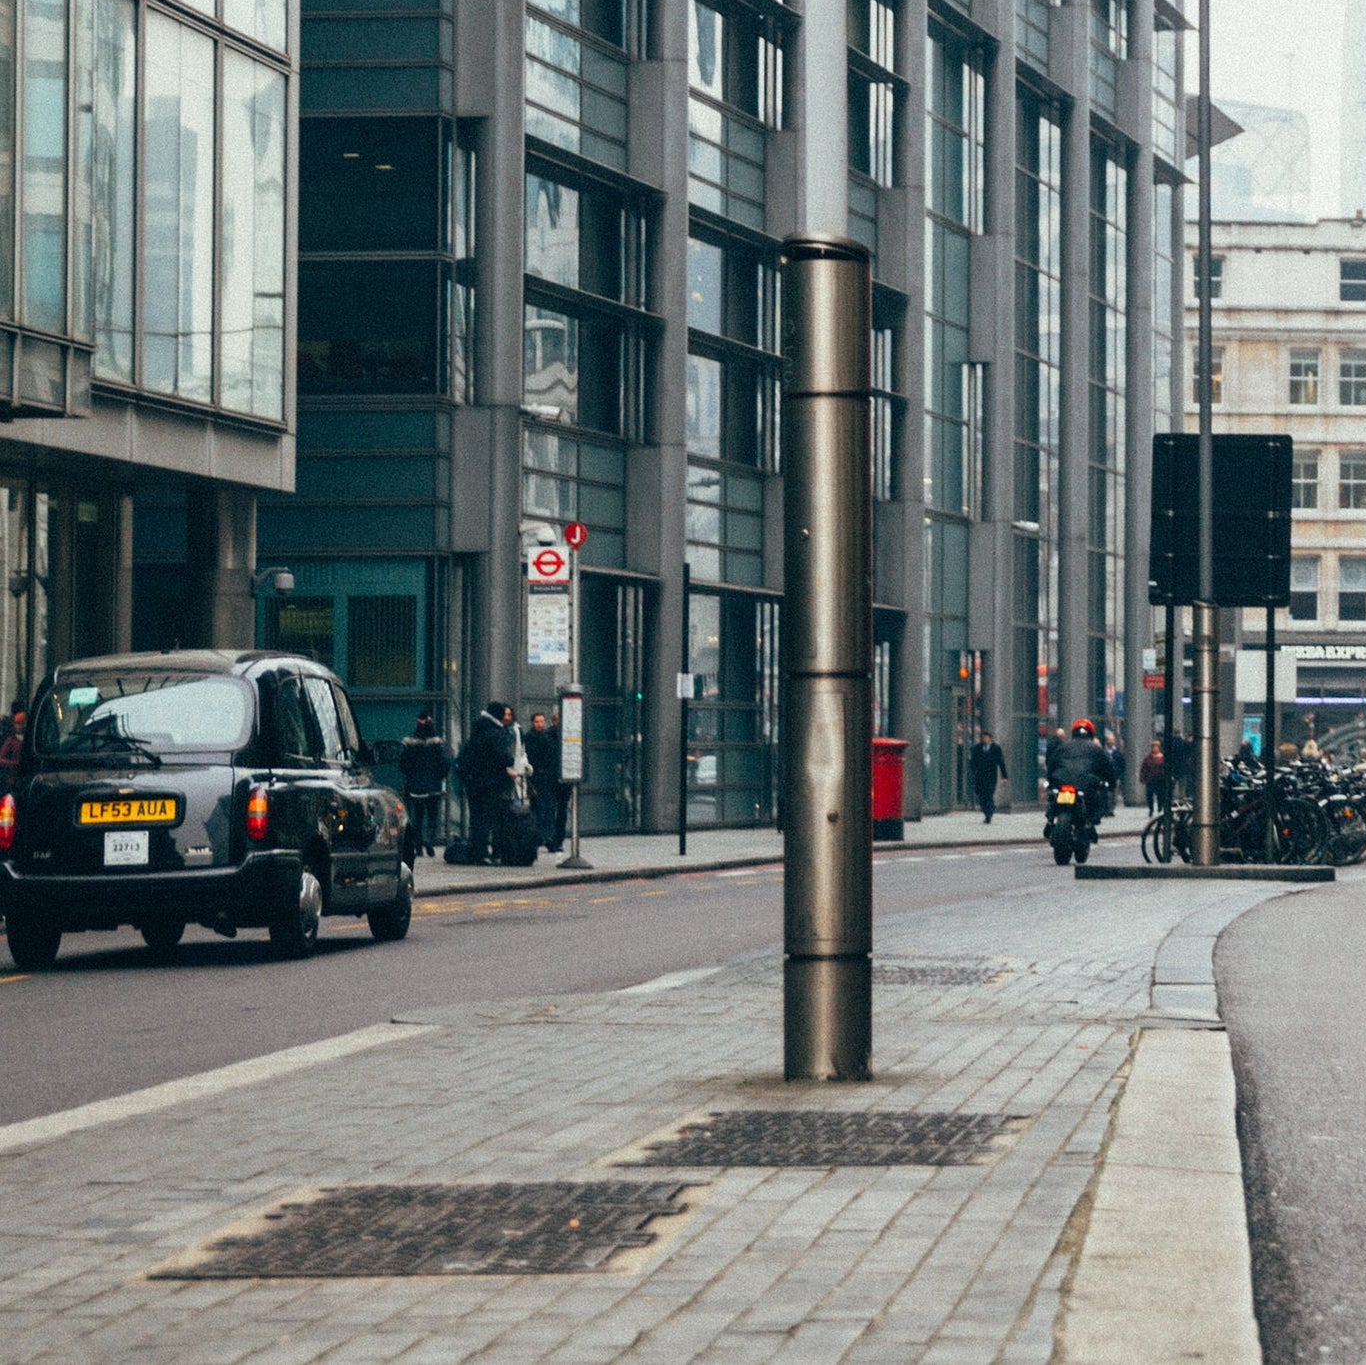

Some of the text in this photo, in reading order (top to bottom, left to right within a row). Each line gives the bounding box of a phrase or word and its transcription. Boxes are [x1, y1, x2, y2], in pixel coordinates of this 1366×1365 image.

[570, 525, 581, 543] J
[89, 800, 168, 819] LF53 AUA
